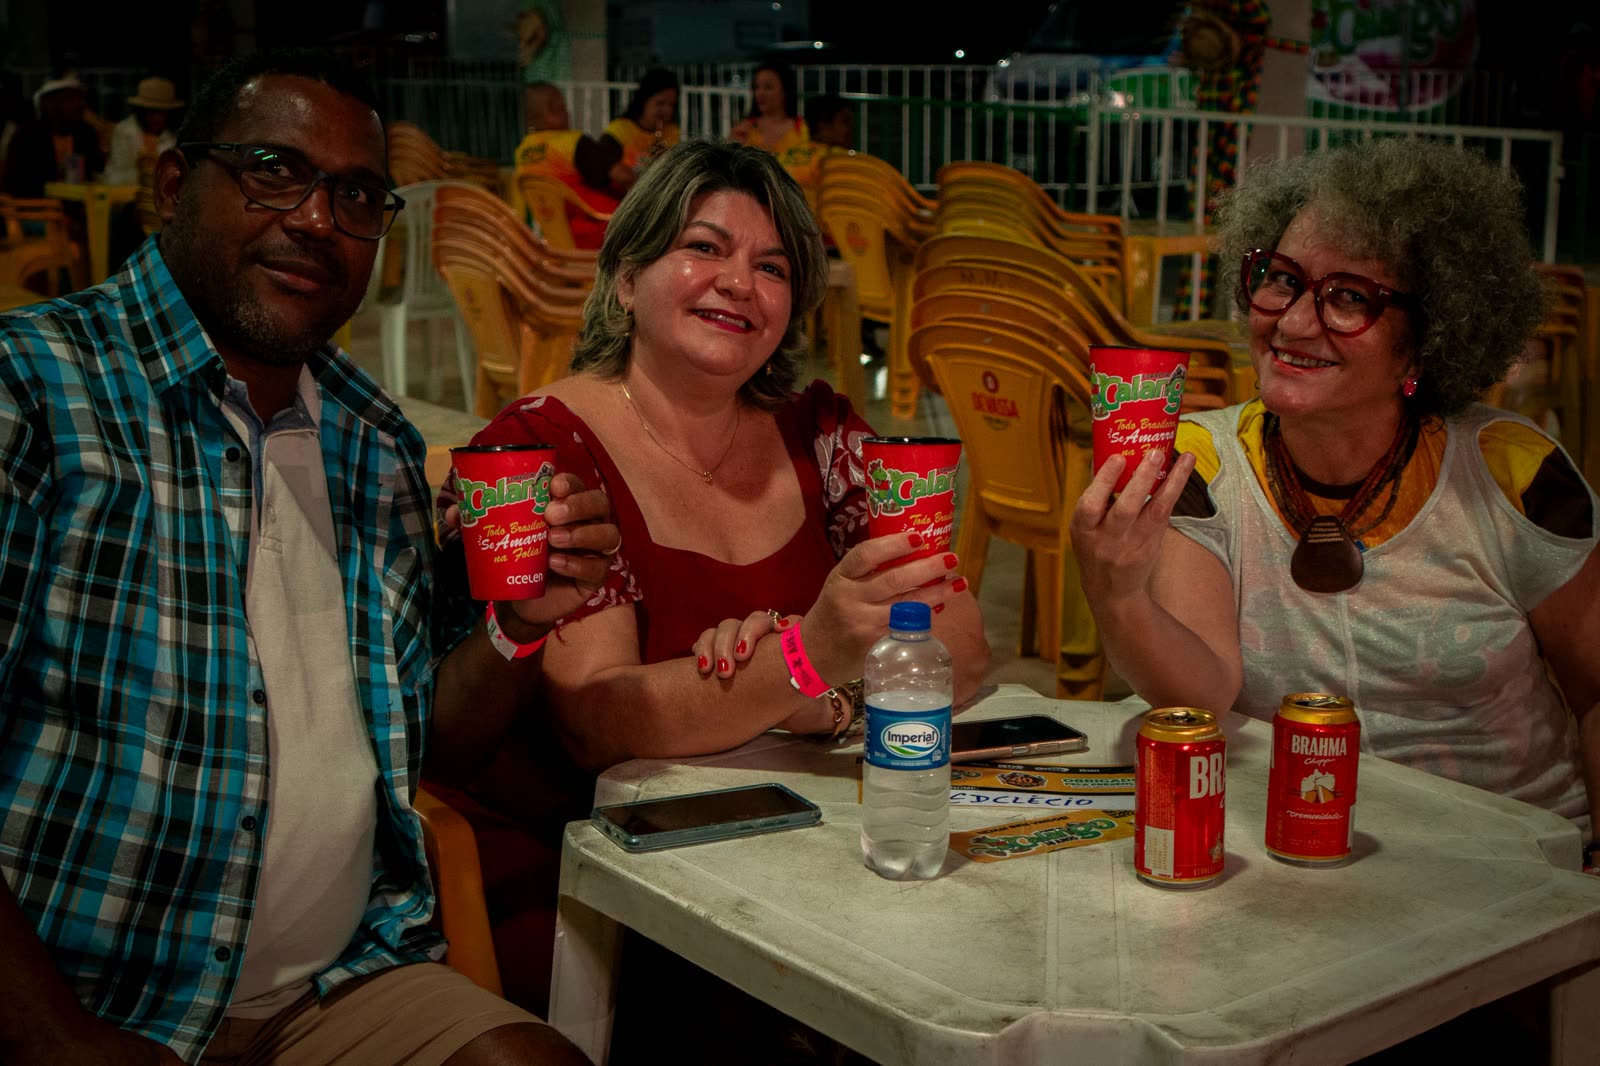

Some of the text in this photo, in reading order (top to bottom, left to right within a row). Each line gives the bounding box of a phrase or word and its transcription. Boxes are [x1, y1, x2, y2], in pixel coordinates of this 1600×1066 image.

[1101, 374, 1185, 415] Calang
[1114, 418, 1136, 431] Todo
[1121, 448, 1136, 456] na
[465, 474, 553, 518] Calang
[909, 513, 931, 526] Todo
[483, 520, 547, 538] Todo Brasileir
[481, 530, 548, 552] Se Amarra
[493, 542, 544, 563] na Folia!
[506, 573, 544, 584] acelen
[887, 730, 936, 745] Imperial
[1291, 734, 1348, 757] BRAHMA
